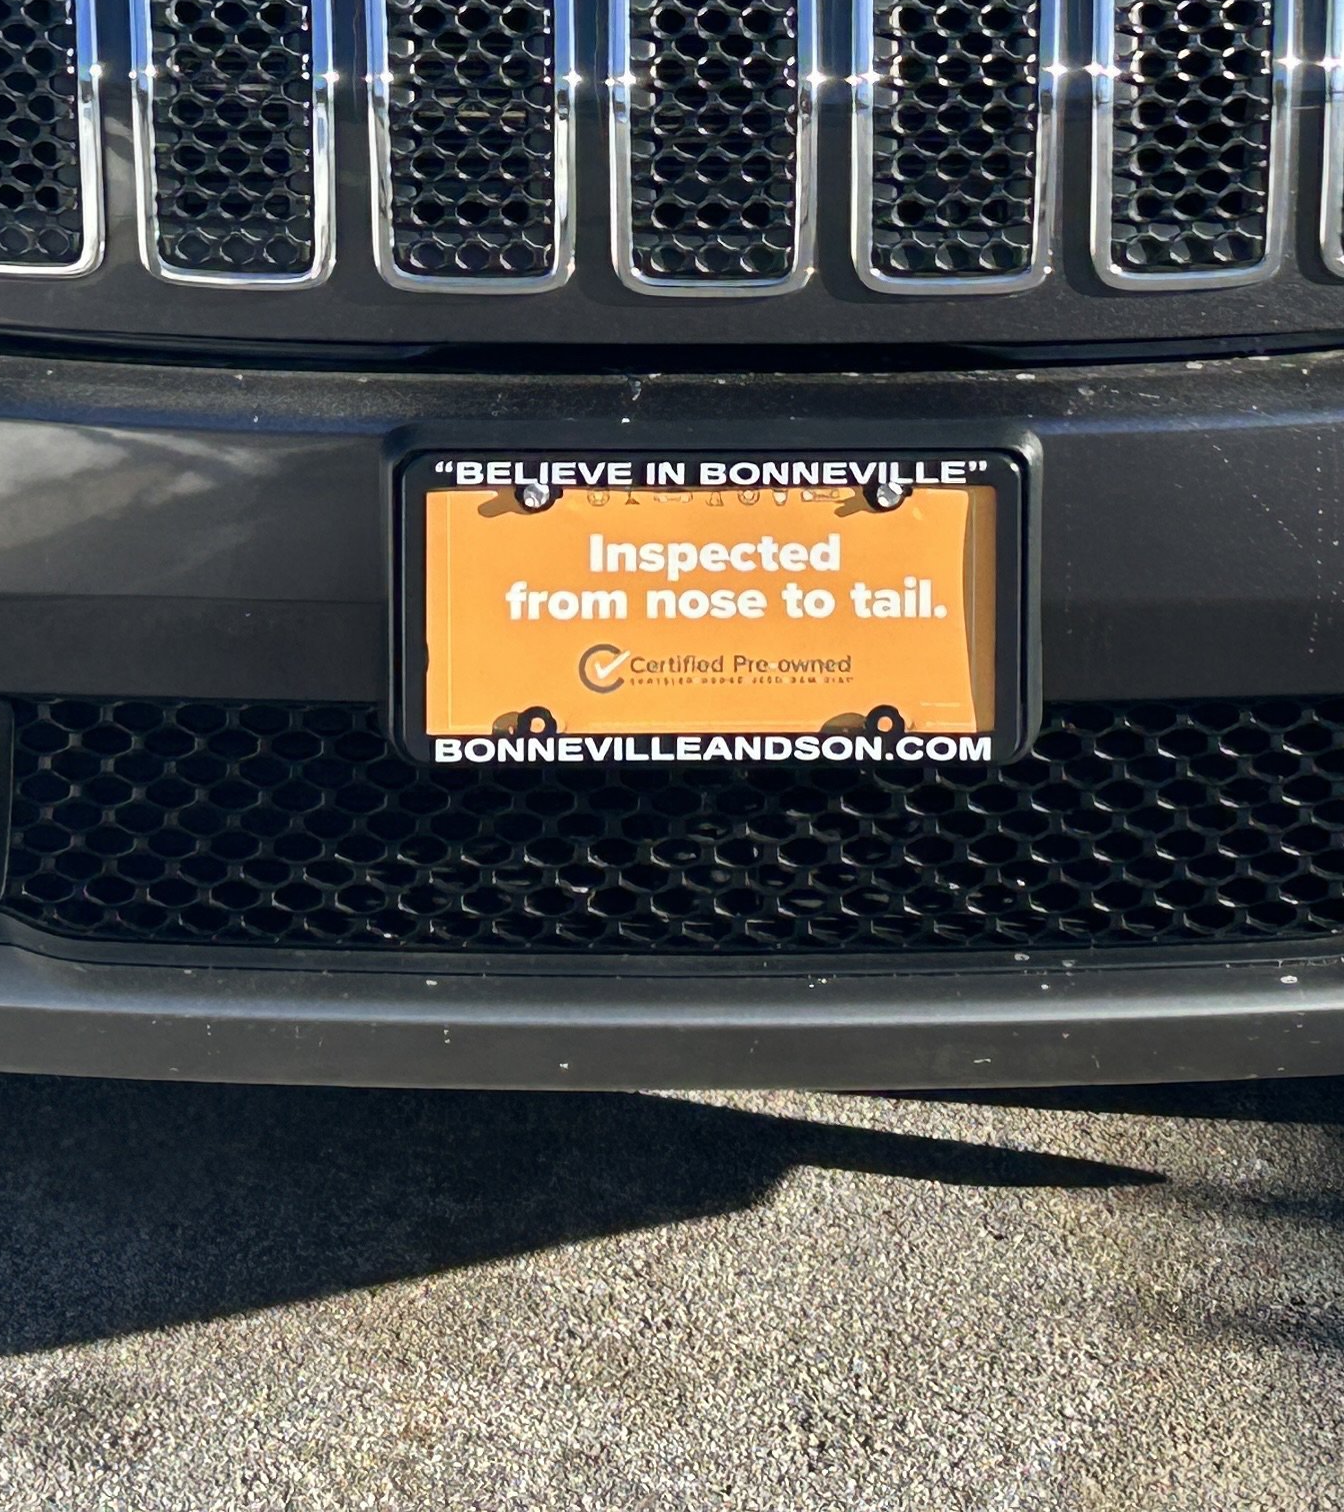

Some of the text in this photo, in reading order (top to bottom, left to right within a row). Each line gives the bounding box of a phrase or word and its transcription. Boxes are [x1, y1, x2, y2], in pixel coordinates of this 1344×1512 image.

[646, 462, 685, 485] IN
[589, 533, 841, 581] Inspected
[506, 576, 948, 620] from nose to tail.
[630, 654, 724, 674] Certified
[434, 736, 992, 764] BONNEVILLEANDSON.COM
